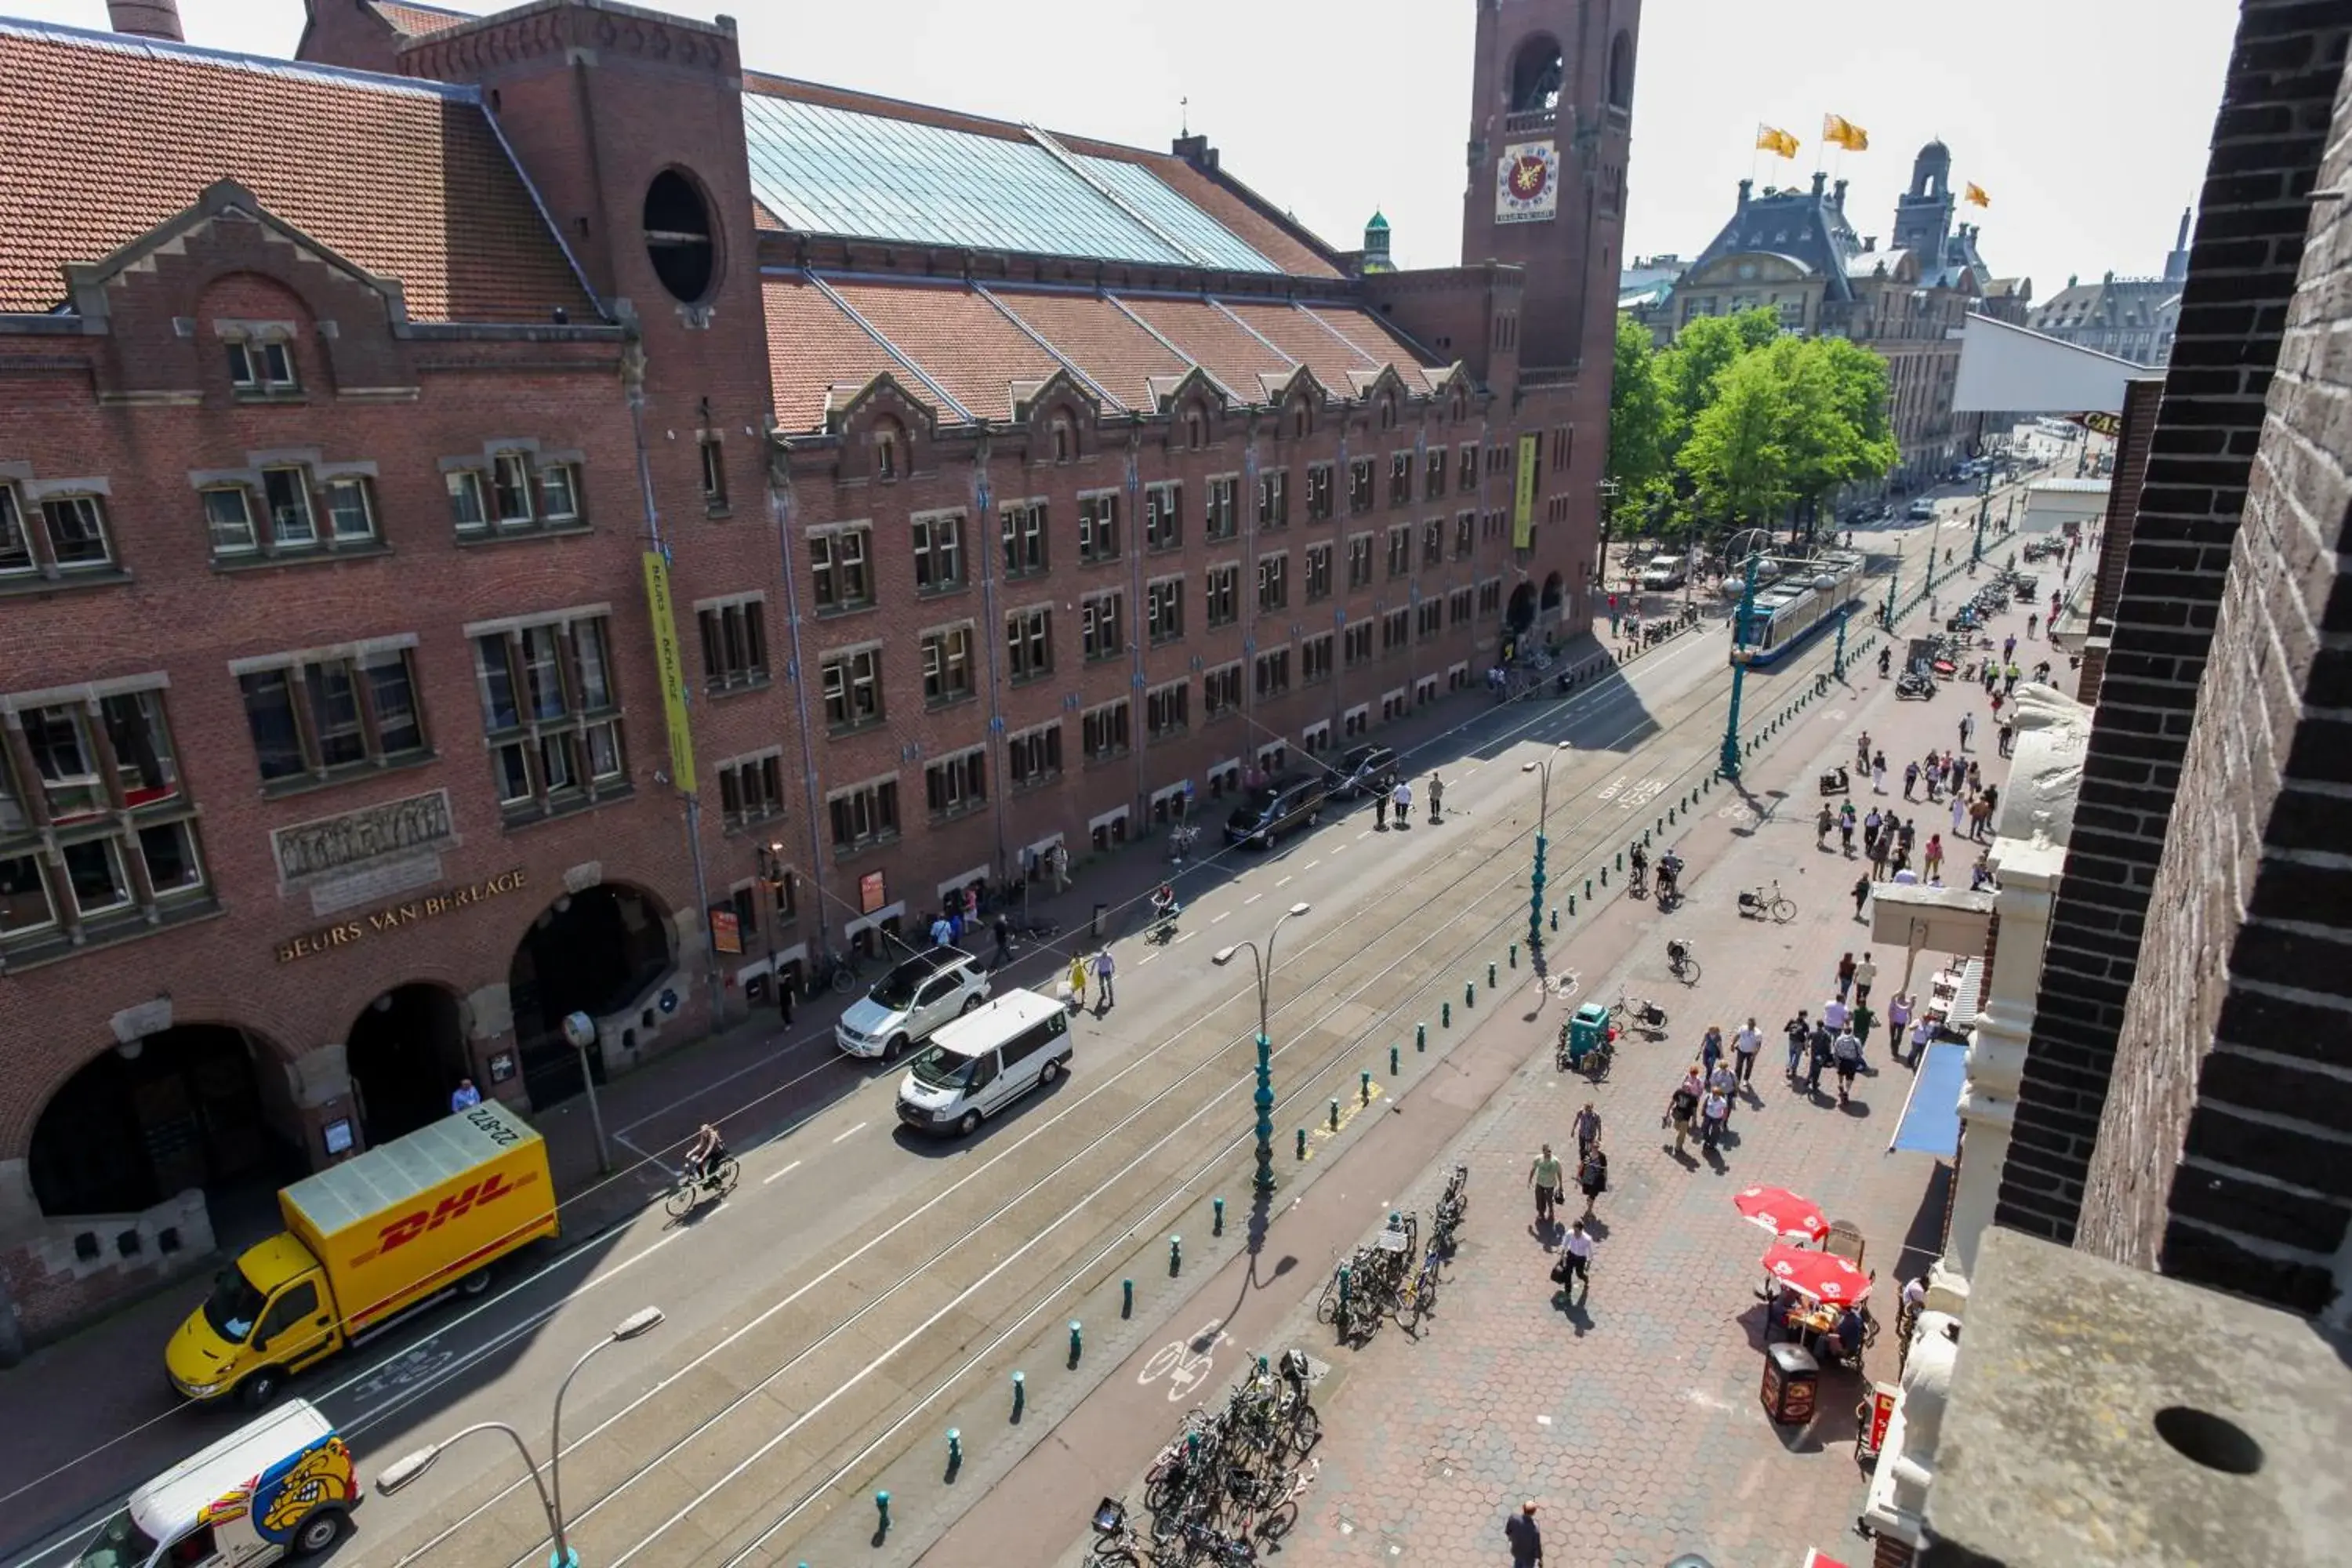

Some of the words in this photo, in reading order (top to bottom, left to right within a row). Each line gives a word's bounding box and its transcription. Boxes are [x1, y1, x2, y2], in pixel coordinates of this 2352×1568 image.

[278, 921, 361, 963] BEURS
[368, 904, 416, 931] VAN
[425, 870, 528, 916] BERLAGE
[466, 1109, 518, 1145] 22-872
[378, 1173, 514, 1254] DHL
